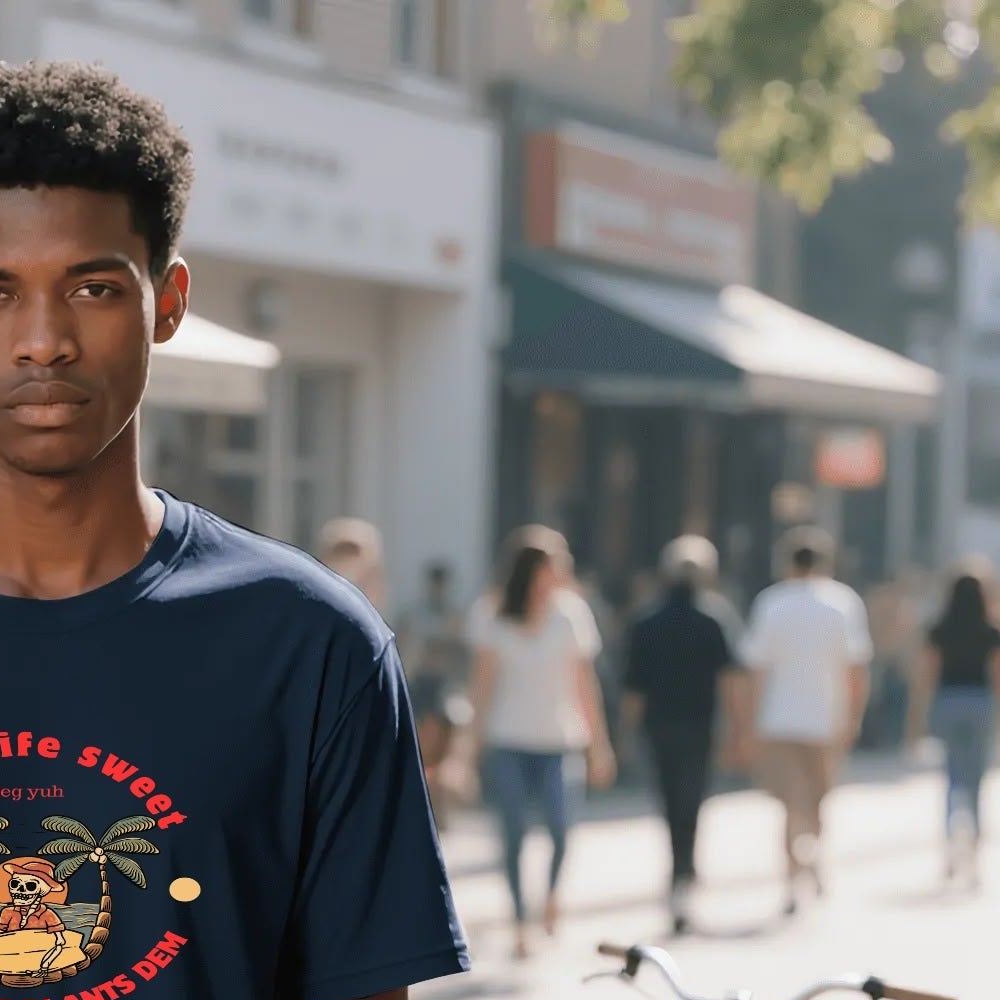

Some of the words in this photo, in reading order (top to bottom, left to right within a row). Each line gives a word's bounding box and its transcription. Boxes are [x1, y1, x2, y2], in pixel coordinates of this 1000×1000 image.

[27, 785, 64, 800] yuh
[77, 745, 187, 830] sweet
[132, 931, 188, 981] DEM
